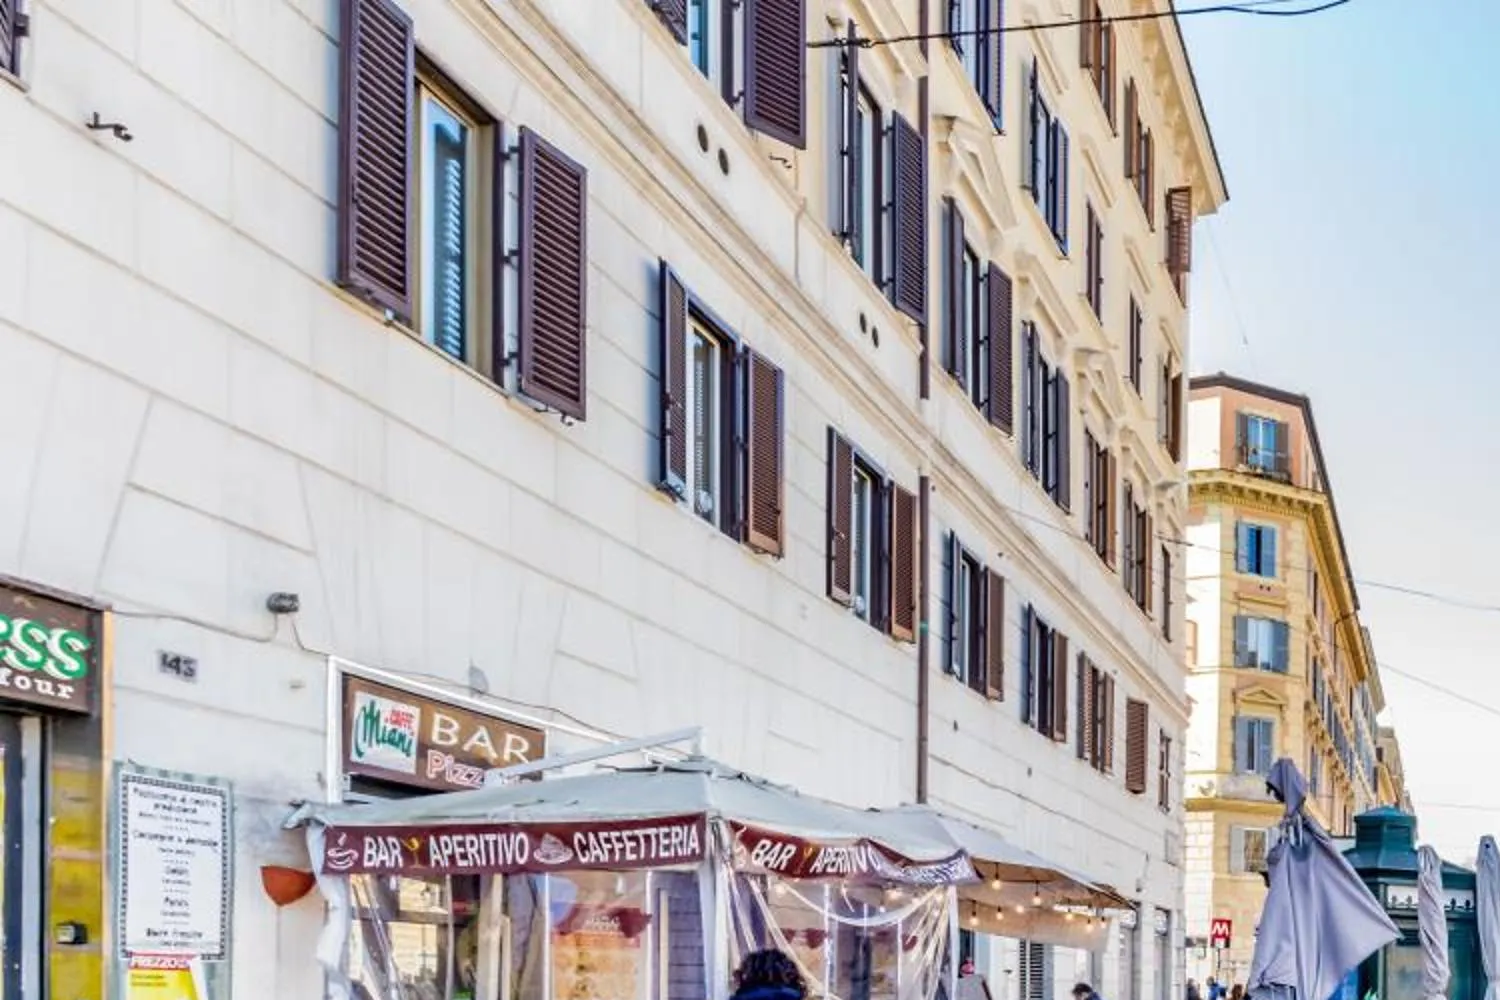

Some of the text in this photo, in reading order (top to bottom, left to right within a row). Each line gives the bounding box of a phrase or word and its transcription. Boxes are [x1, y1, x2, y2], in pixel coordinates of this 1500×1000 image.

[431, 713, 530, 765] BAR
[425, 749, 487, 790] Pizz
[362, 824, 700, 868] BAR APERITIVO CAFFETTERIA
[753, 839, 798, 872] BAR
